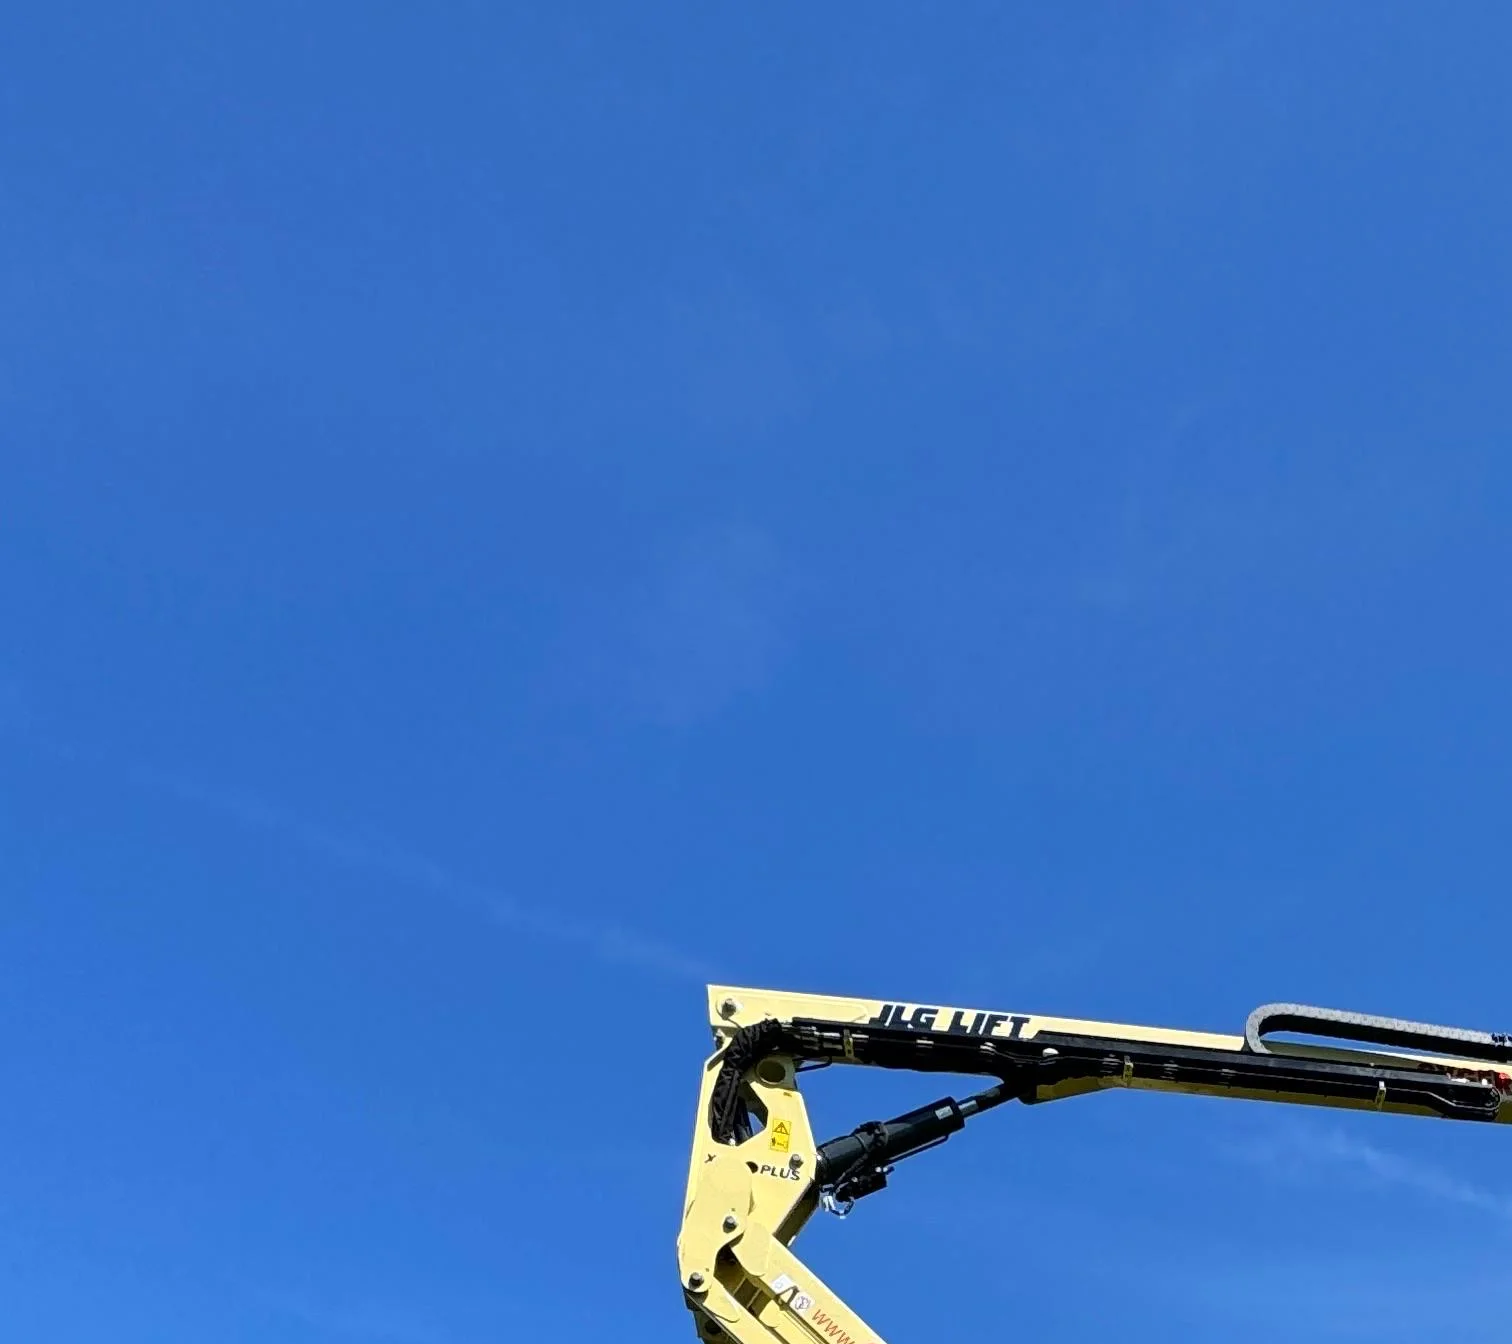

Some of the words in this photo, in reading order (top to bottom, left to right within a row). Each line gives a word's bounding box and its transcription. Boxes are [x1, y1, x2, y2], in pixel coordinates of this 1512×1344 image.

[868, 1003, 939, 1032] JLG
[946, 1010, 1031, 1038] LIFT
[759, 1164, 801, 1181] PLUS
